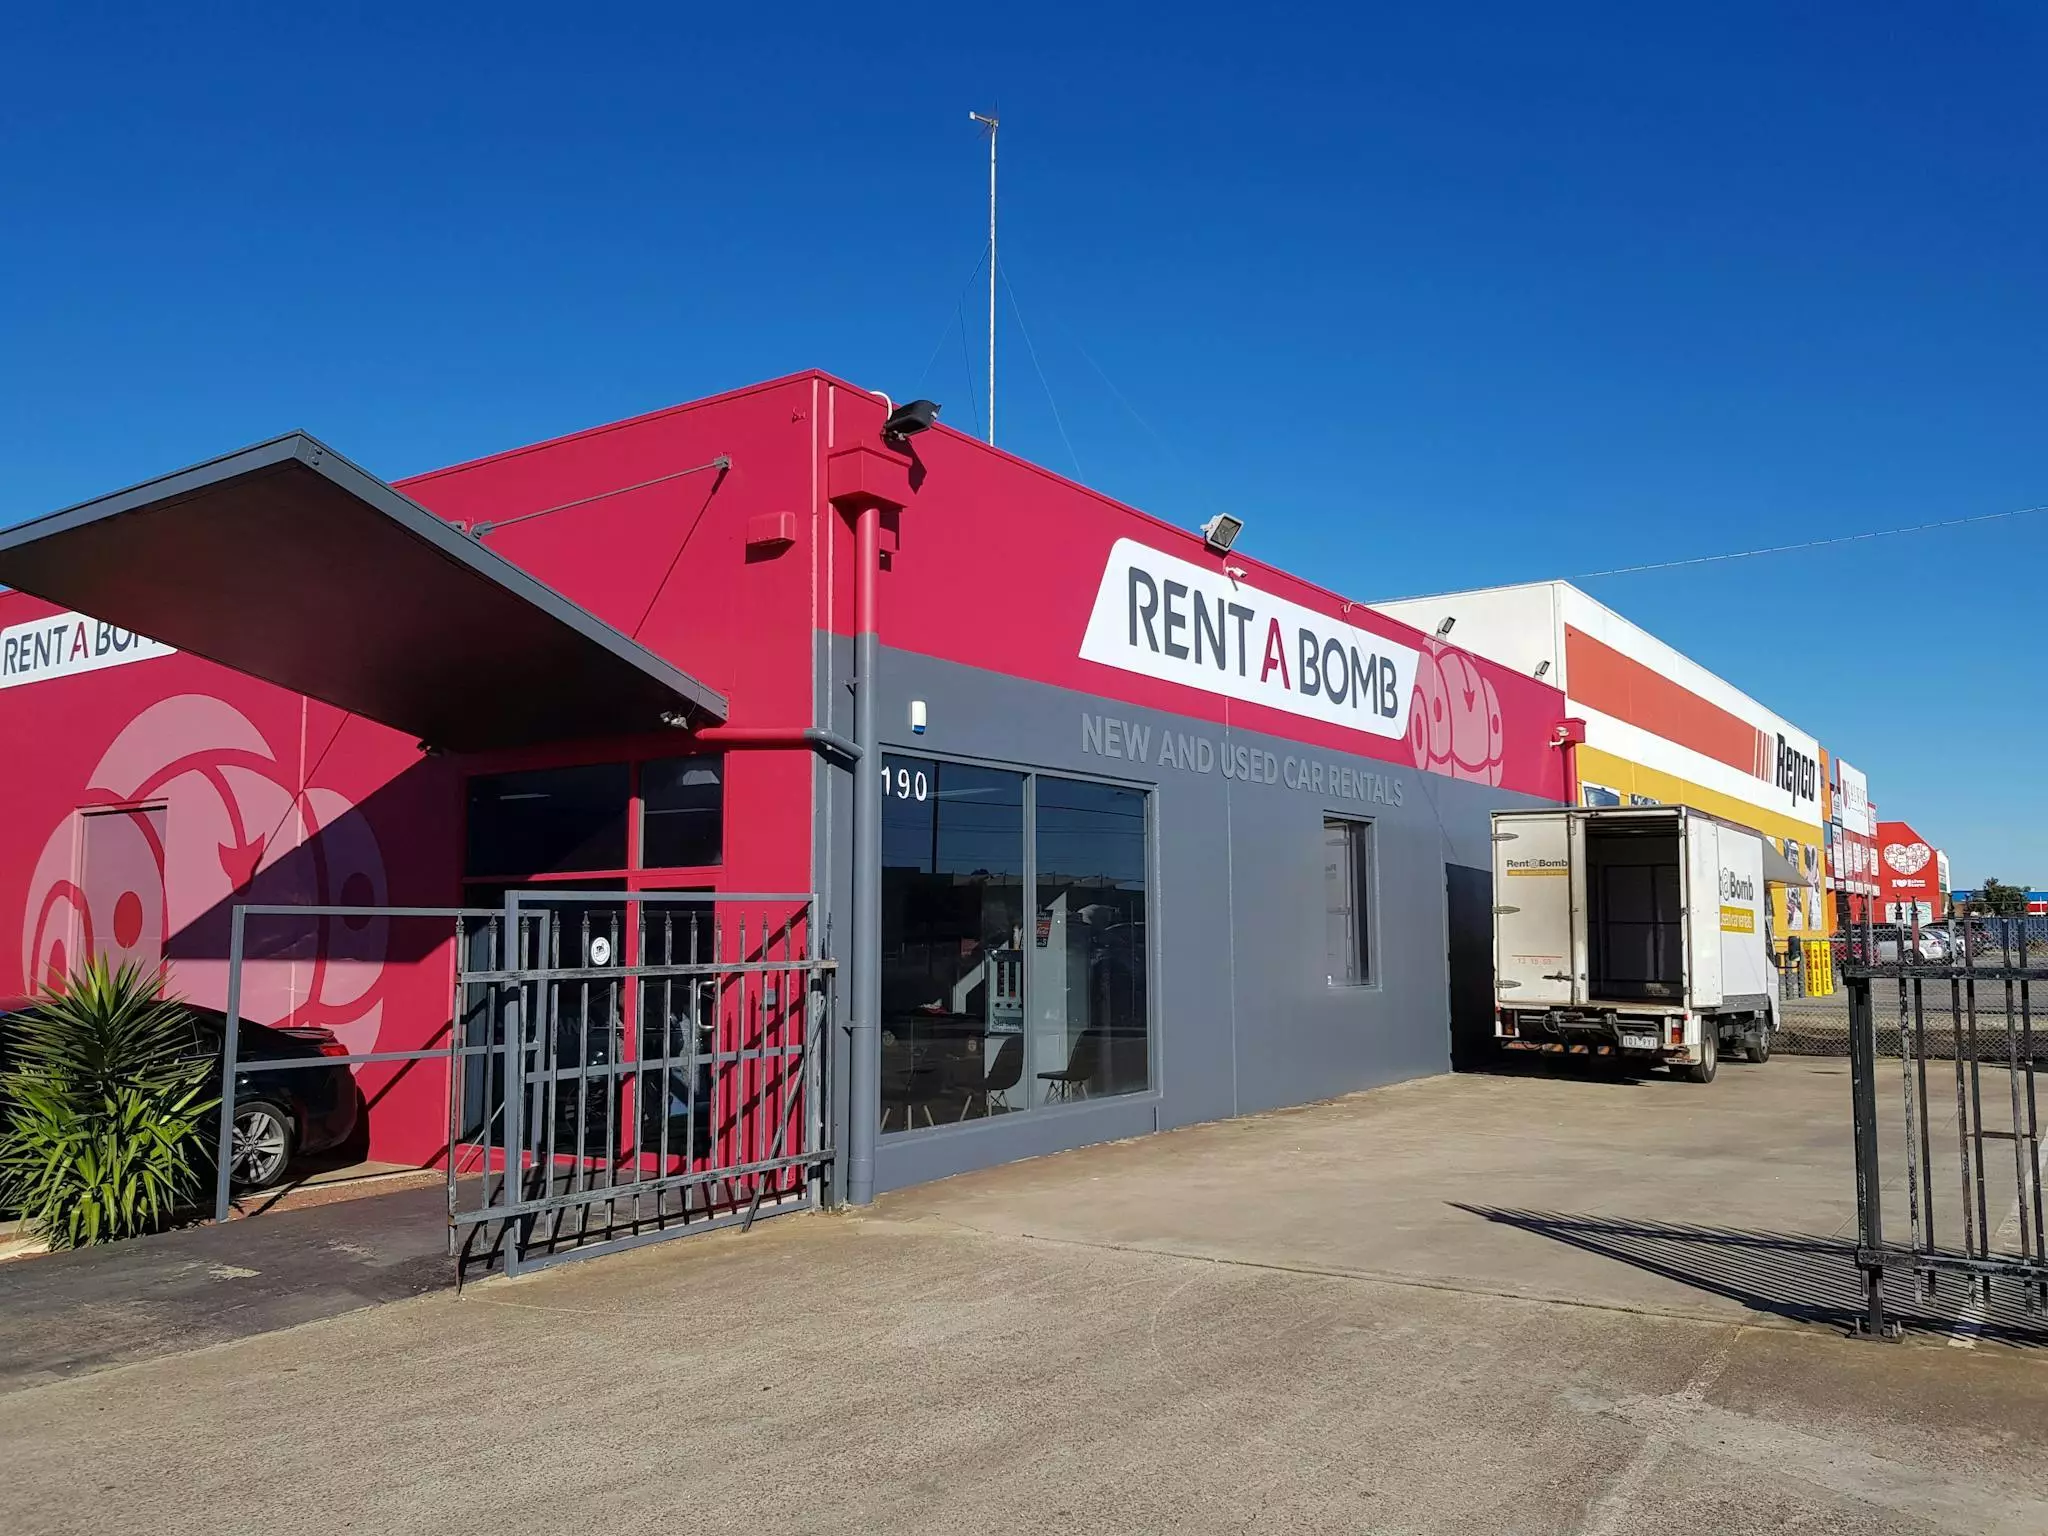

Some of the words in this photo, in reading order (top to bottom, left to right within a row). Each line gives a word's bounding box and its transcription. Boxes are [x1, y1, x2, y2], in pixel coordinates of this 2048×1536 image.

[3, 624, 69, 676] RENT
[70, 621, 89, 662] A
[95, 619, 157, 656] BO
[1128, 566, 1255, 677] RENT
[1260, 617, 1291, 690] A
[1299, 627, 1398, 719] BOMB
[881, 766, 928, 801] 190
[1082, 713, 1150, 763] NEW
[1157, 730, 1215, 774] AND
[1220, 742, 1278, 785] USED
[1283, 755, 1324, 794] CAR
[1328, 764, 1403, 808] RENTALS
[1776, 732, 1816, 807] Repco
